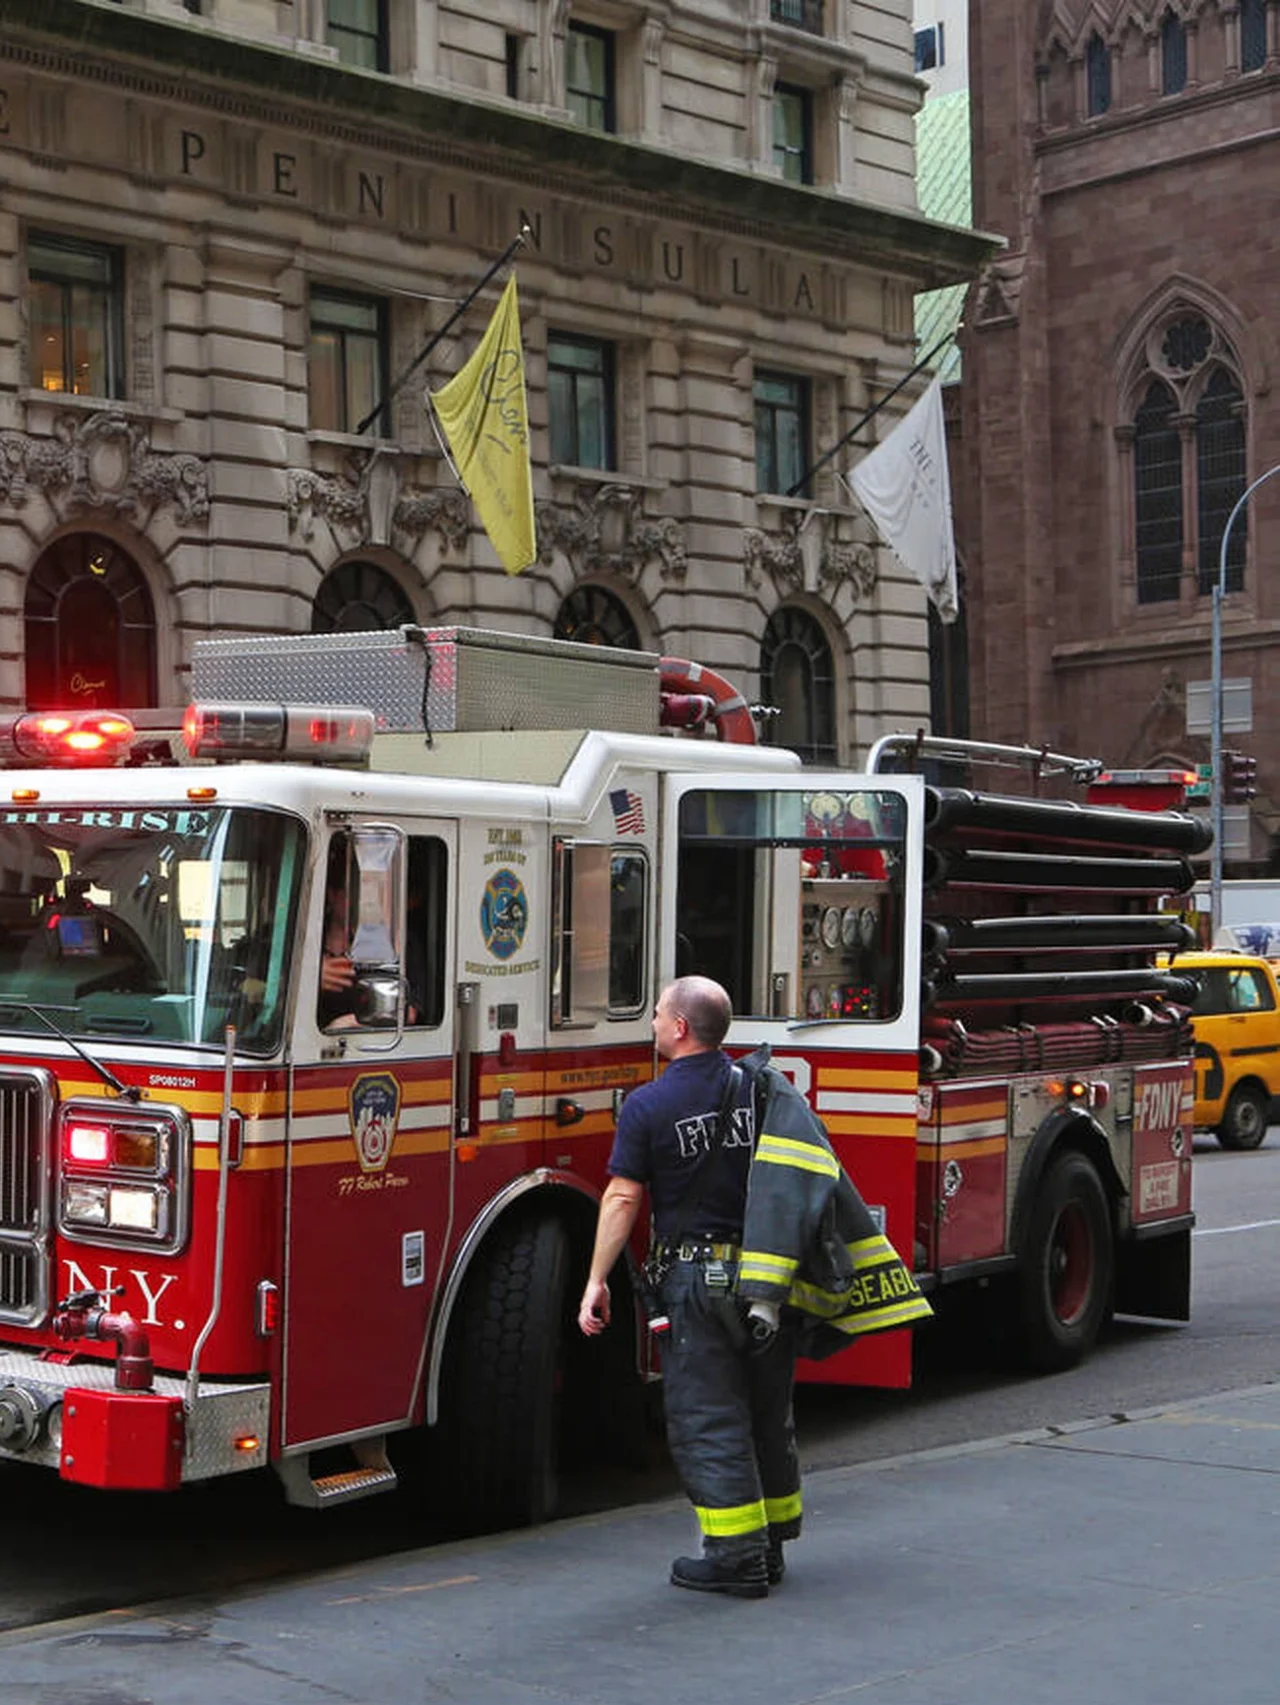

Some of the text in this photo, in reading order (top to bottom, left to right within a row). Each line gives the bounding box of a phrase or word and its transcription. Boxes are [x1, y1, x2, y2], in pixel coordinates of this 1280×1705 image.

[181, 131, 814, 309] PENINSULA
[4, 811, 210, 837] HI-RISE
[1139, 1080, 1184, 1133] FDNY
[62, 1259, 186, 1330] N.Y.
